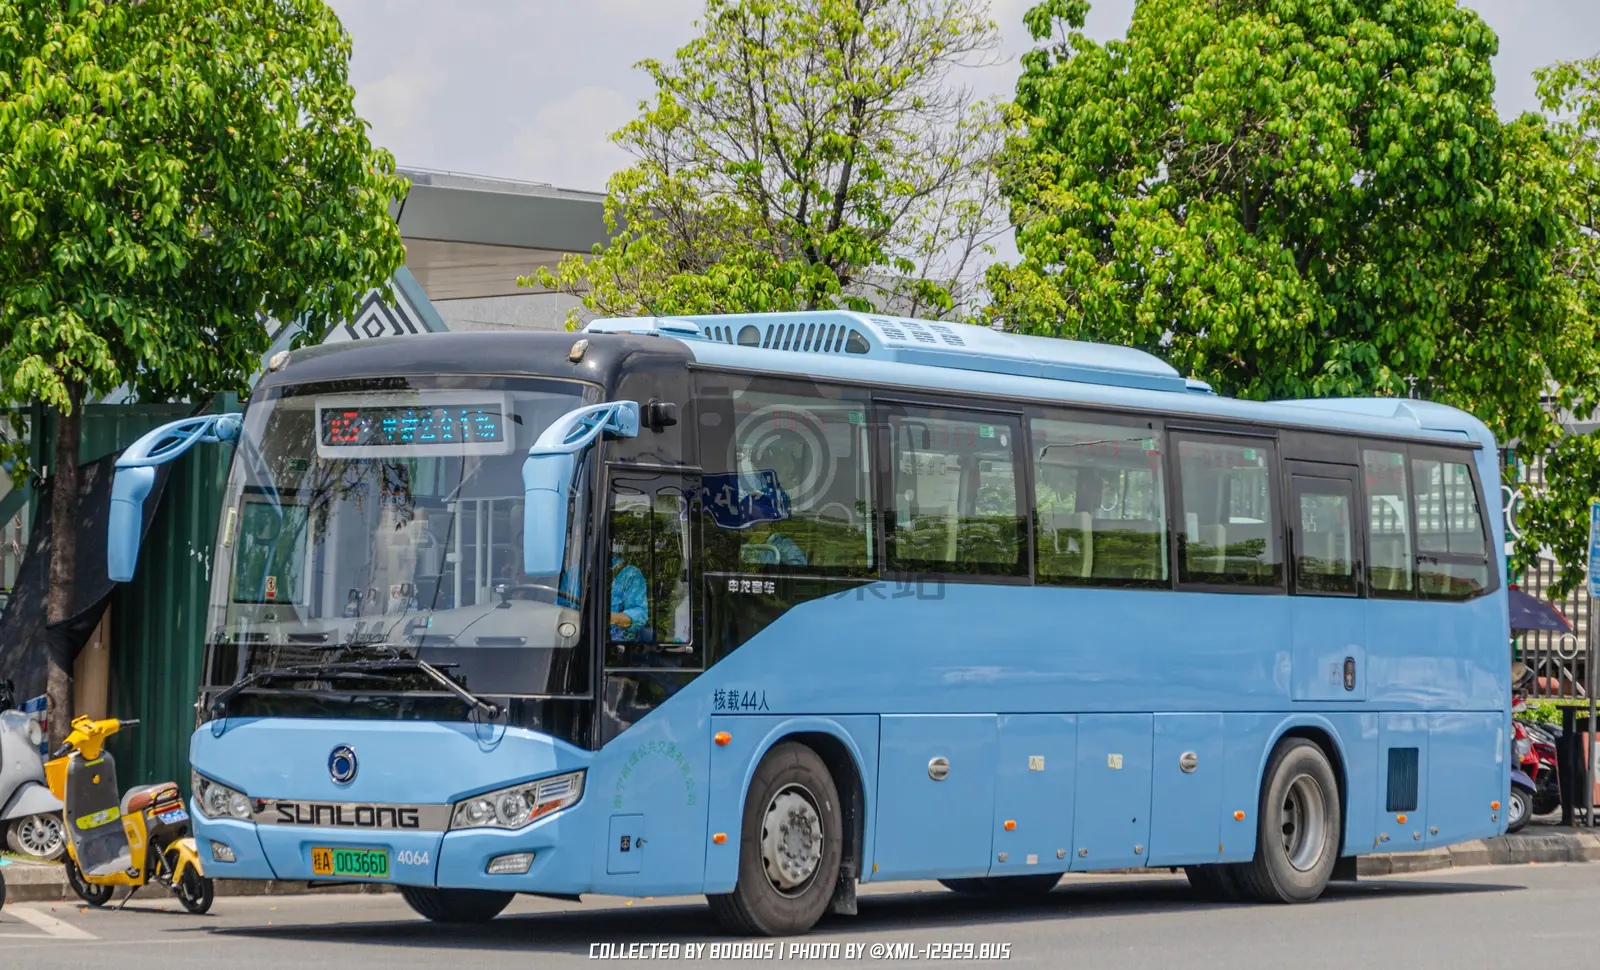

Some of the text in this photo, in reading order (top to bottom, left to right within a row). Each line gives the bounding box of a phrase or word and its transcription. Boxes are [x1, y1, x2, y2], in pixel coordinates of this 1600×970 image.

[728, 579, 776, 595] 申龙客车
[713, 688, 770, 712] 核载44人
[276, 803, 420, 829] SUNLONG
[397, 850, 430, 866] 4064
